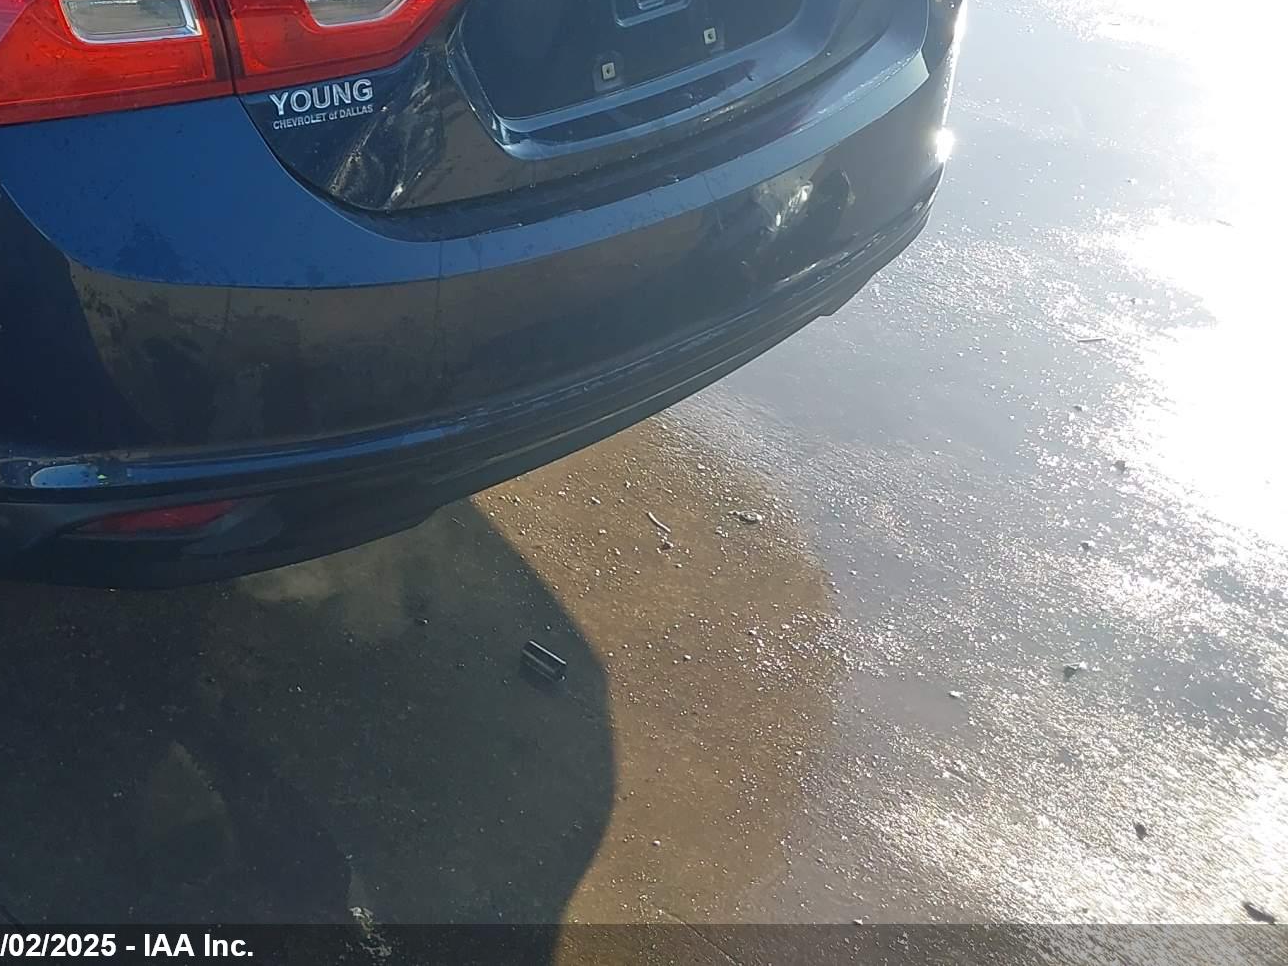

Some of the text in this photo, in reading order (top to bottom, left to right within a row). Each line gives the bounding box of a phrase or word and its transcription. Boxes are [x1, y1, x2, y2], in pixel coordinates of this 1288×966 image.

[269, 78, 373, 116] YOUNG
[273, 104, 374, 130] CHEVROLET of DALLAS
